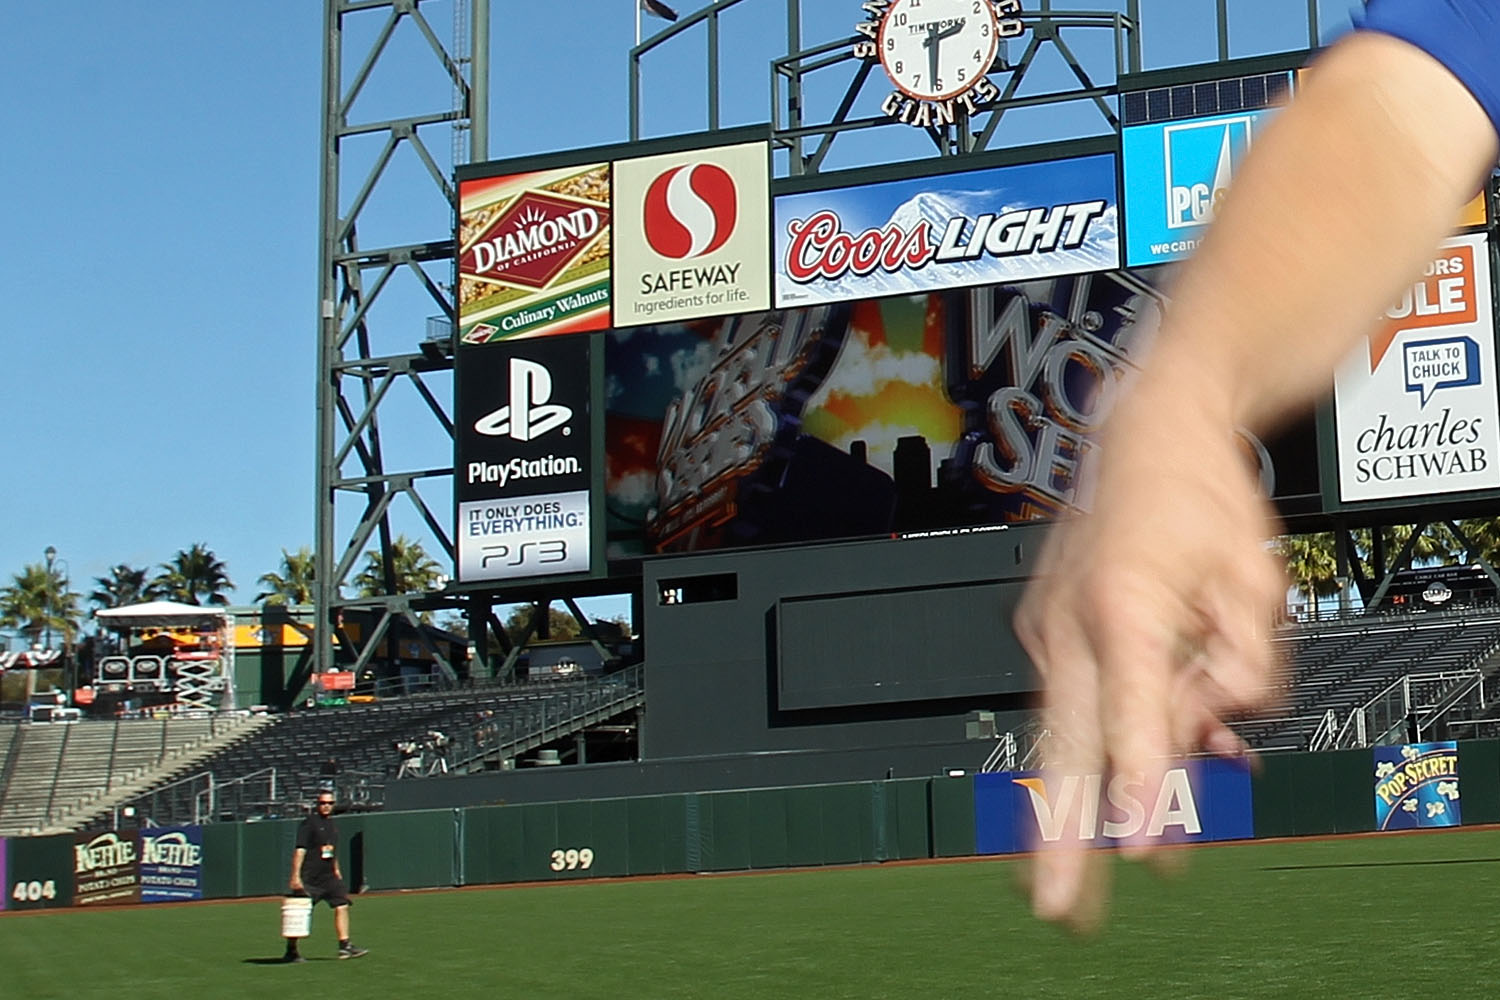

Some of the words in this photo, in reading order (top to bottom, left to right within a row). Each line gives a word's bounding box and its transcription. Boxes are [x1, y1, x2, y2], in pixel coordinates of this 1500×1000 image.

[973, 1, 981, 15] 2
[893, 12, 908, 28] 10
[981, 24, 990, 37] 3
[887, 38, 895, 51] 9
[895, 61, 903, 74] 8
[973, 50, 982, 63] 4
[913, 75, 921, 88] 7
[935, 78, 943, 91] 6
[957, 69, 966, 82] 5
[880, 77, 999, 127] GIANTS
[1172, 183, 1227, 224] PG&
[472, 207, 599, 273] DIAMOND
[786, 211, 934, 281] Coors
[936, 201, 1105, 263] LIGHT
[497, 262, 510, 272] OF
[514, 241, 577, 266] CALIFORNIA
[640, 262, 741, 294] SAFEWAY
[634, 295, 703, 315] Ingredients
[706, 292, 725, 305] for
[726, 288, 750, 302] life.
[1384, 276, 1467, 320] ULE
[501, 306, 556, 331] Culinary
[556, 289, 609, 313] Walnuts
[1412, 349, 1441, 363] TALK
[1445, 347, 1460, 359] TO
[1412, 361, 1461, 380] CHUCK
[1356, 408, 1483, 454] charles
[1356, 448, 1487, 483] SCHWAB
[469, 509, 481, 521] IT
[485, 505, 520, 519] ONLY
[524, 502, 561, 516] DOES
[481, 540, 567, 568] PS3
[1012, 768, 1202, 841] VISA
[551, 848, 594, 871] 399
[12, 880, 57, 902] 404
